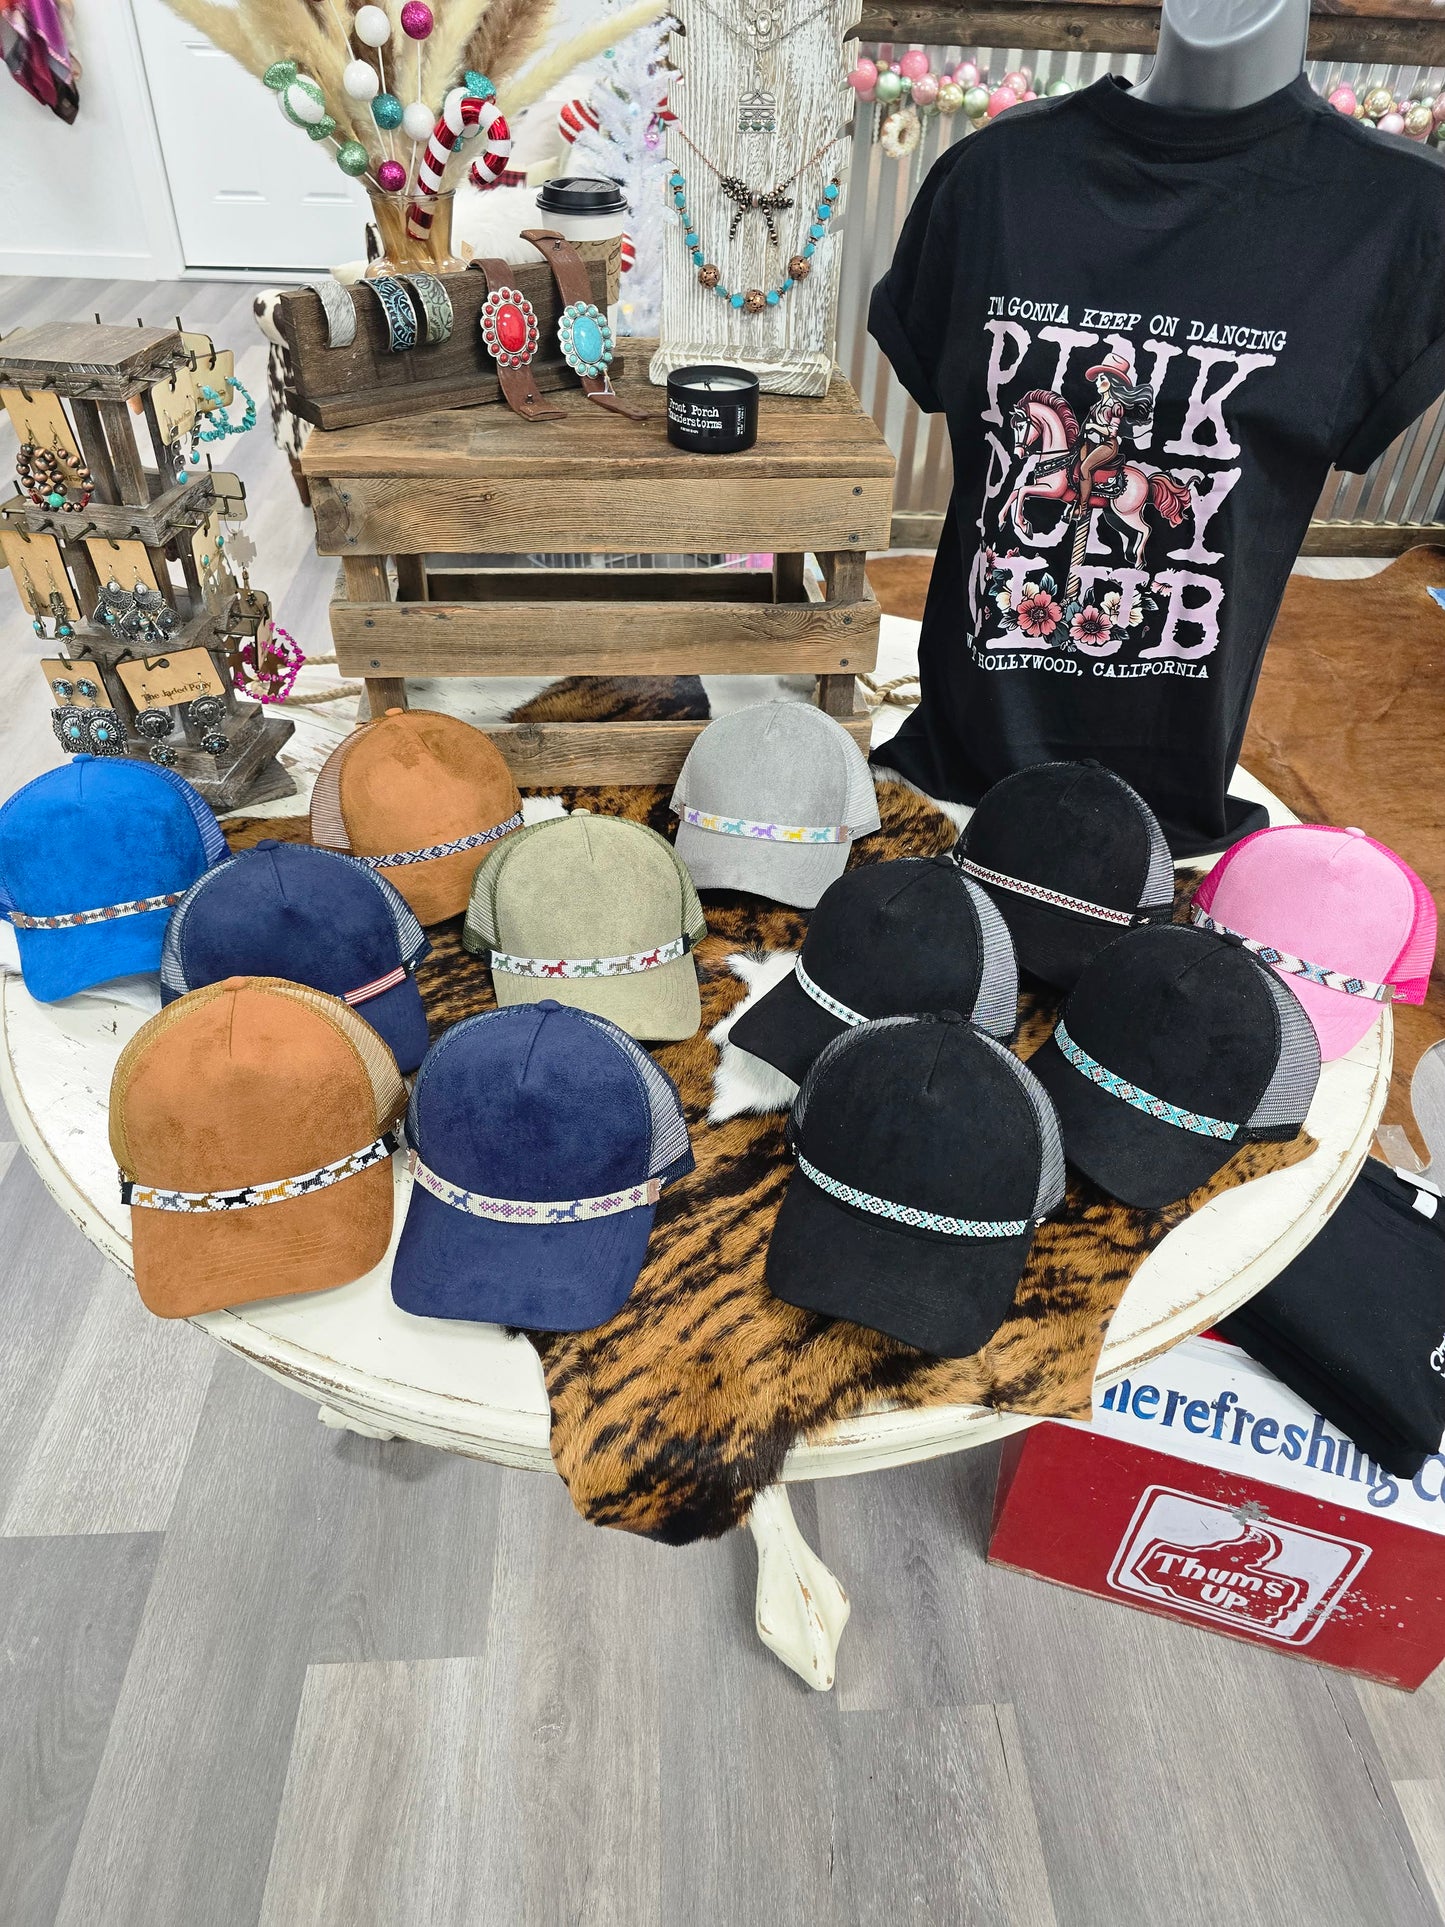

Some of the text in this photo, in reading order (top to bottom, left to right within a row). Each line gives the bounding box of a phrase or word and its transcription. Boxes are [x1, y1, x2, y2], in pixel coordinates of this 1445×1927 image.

[1008, 296, 1069, 324] GONNA
[1080, 308, 1142, 331] KEEP
[1149, 314, 1180, 337] ON
[1186, 320, 1287, 351] DANCING
[691, 404, 719, 417] Porch
[981, 318, 1277, 460] PINK
[978, 653, 1210, 679] HOLLYWOOD, CALIFORNIA
[1411, 1452, 1445, 1505] C
[1154, 1551, 1285, 1598] Thums
[1200, 1583, 1248, 1609] UP
